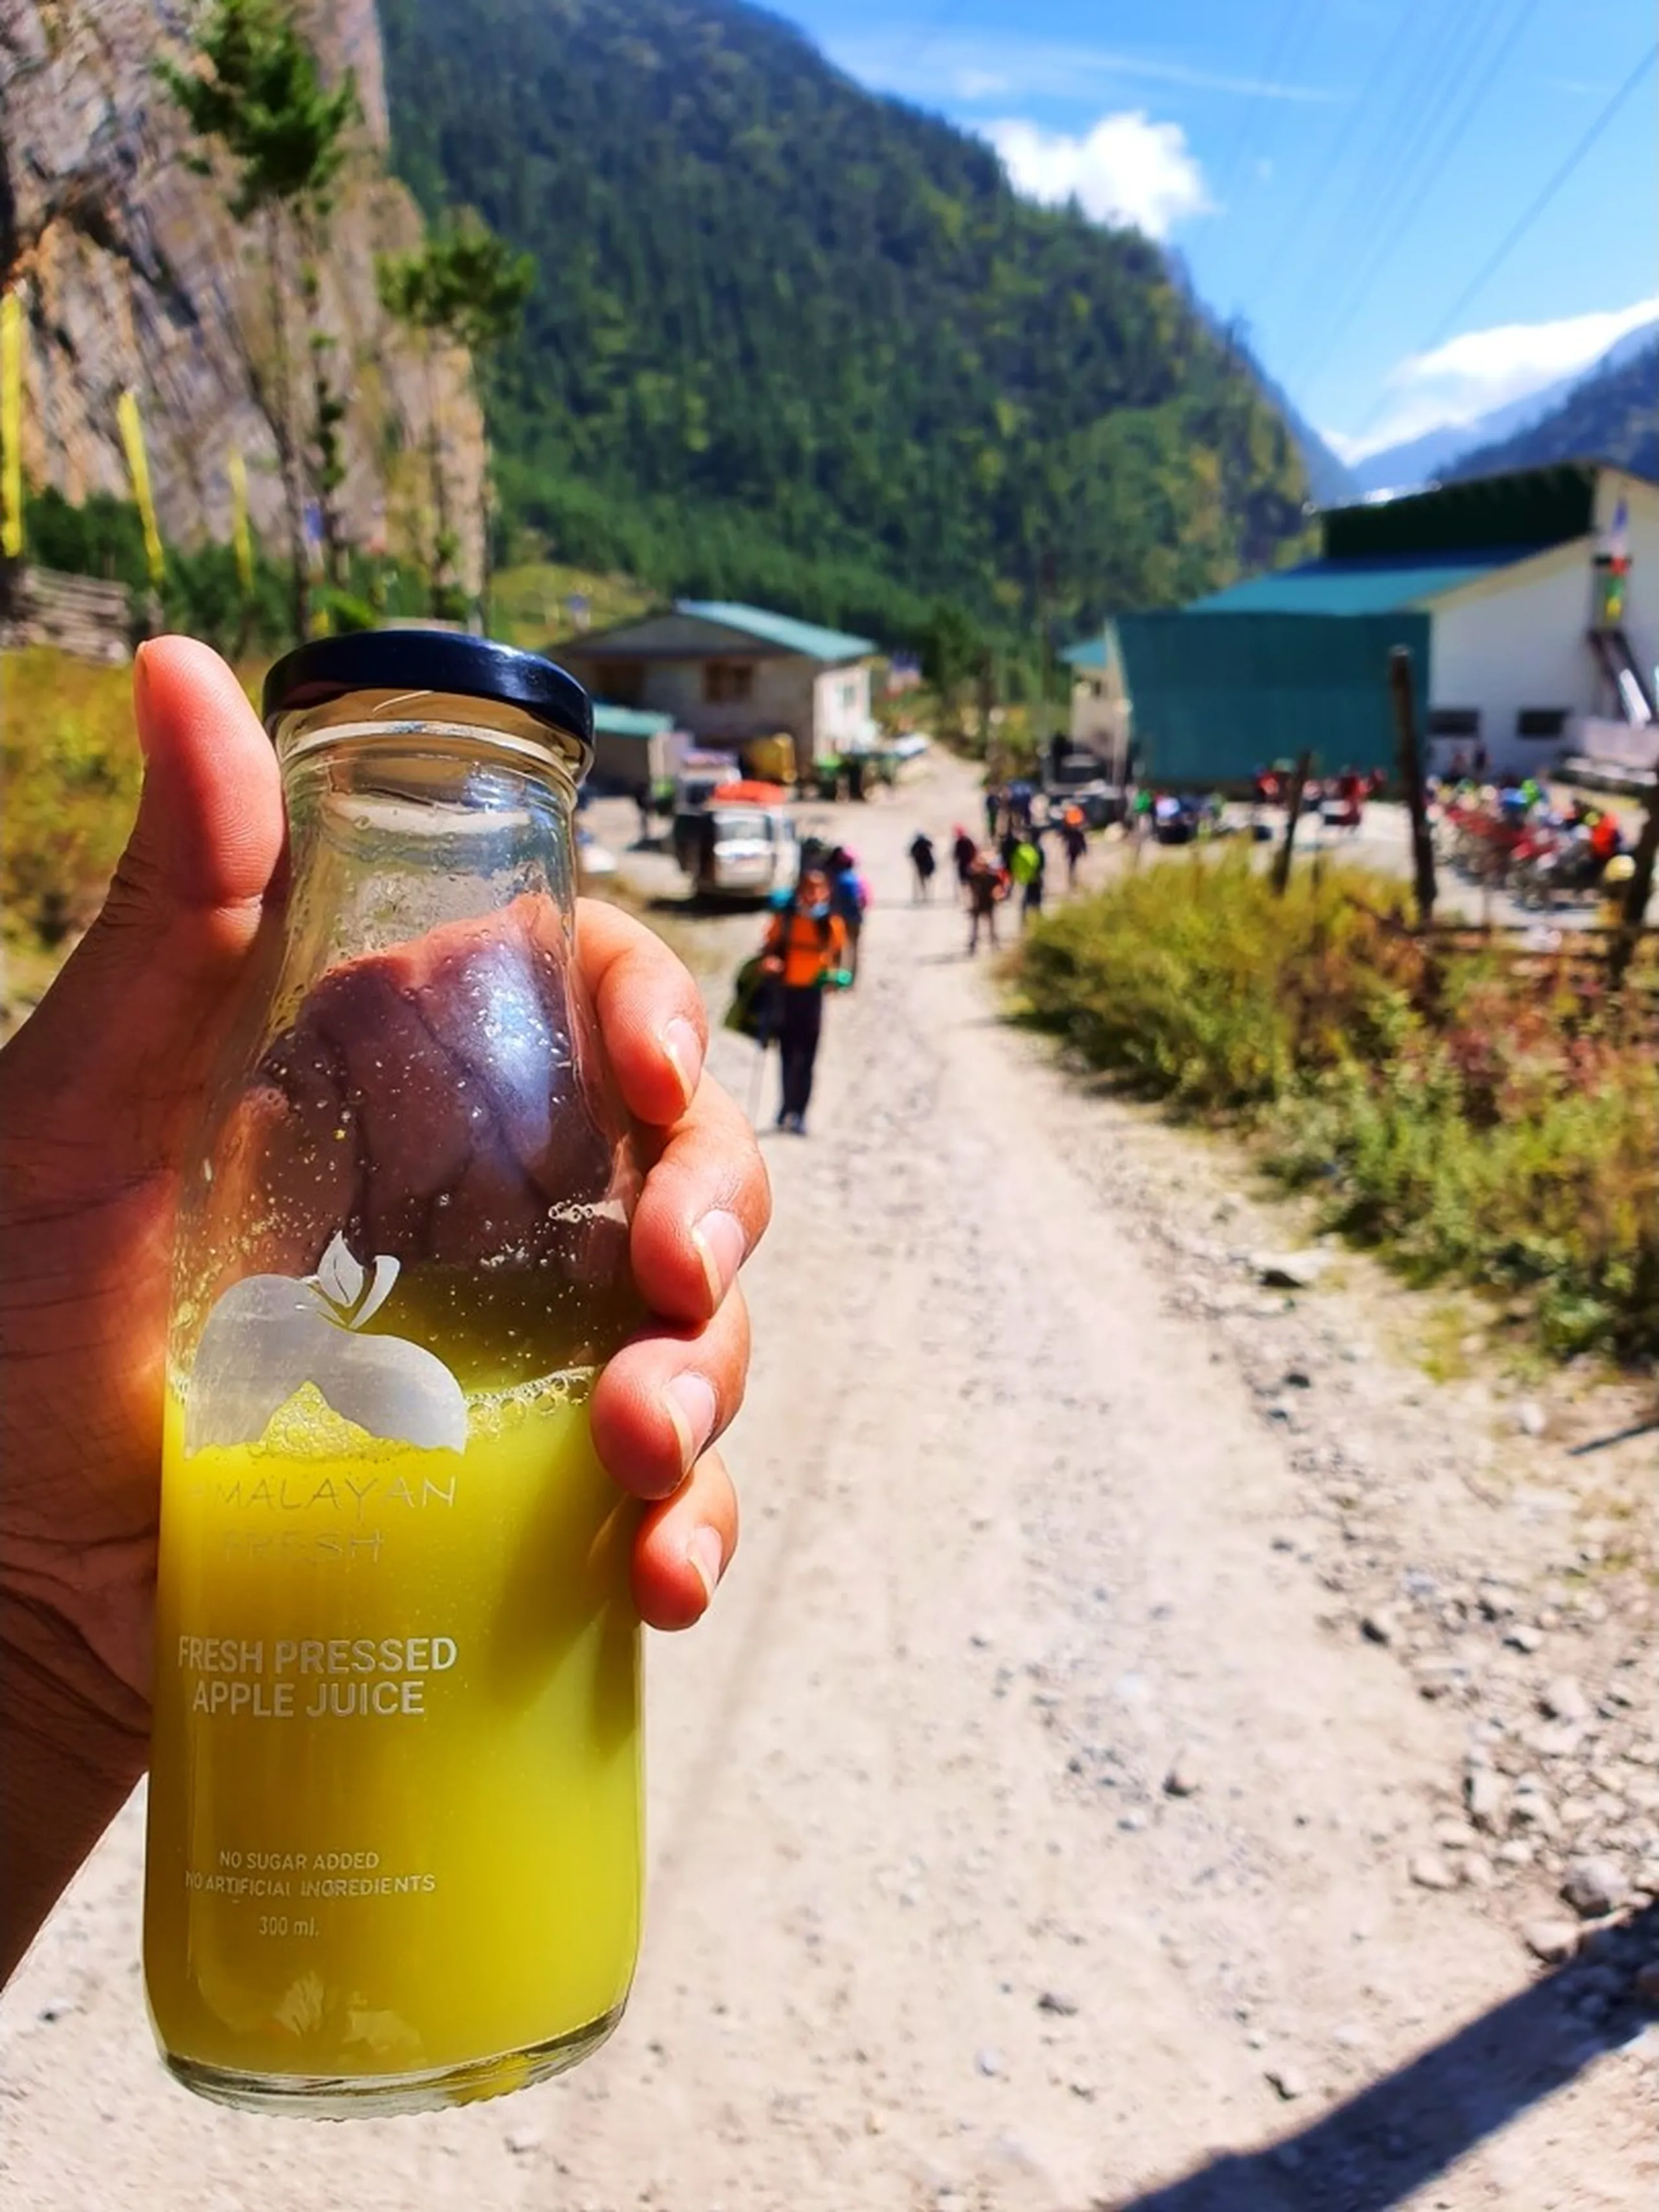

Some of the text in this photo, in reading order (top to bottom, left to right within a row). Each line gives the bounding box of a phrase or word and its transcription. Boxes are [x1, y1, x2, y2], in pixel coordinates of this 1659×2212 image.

[178, 1635, 458, 1673] FRESH PRESSED
[193, 1681, 424, 1717] APPLE JUICE
[220, 1851, 380, 1870] NO SUGAR ADDED
[185, 1870, 202, 1890] NO
[300, 1874, 436, 1898] INGREDIENTS
[259, 1916, 288, 1937] 300
